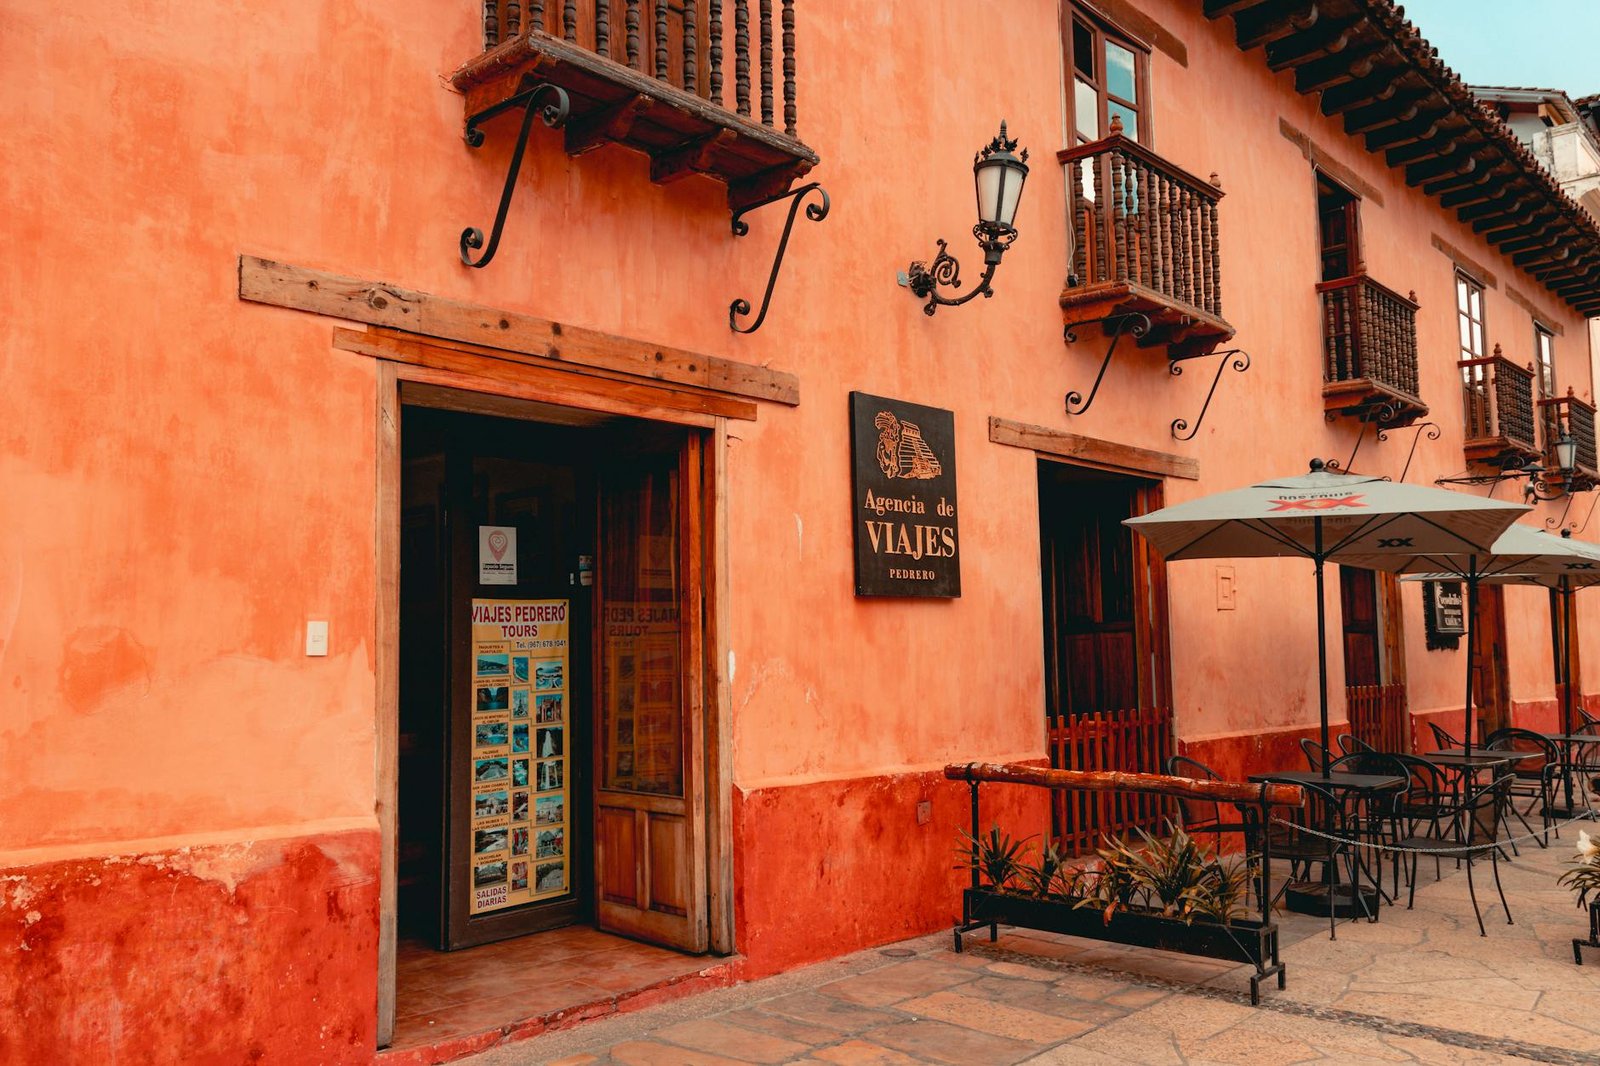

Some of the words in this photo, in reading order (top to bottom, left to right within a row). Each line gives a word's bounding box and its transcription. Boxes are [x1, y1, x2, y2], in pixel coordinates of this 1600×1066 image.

[864, 488, 925, 516] Agencia
[937, 496, 955, 517] de
[865, 520, 956, 560] VIAJES
[1376, 537, 1415, 548] XX
[889, 568, 935, 580] PEDRERO
[472, 605, 511, 623] VIAJES
[515, 604, 566, 622] PEDRERO
[501, 625, 538, 637] TOURS
[476, 885, 507, 900] SALIDAS
[477, 895, 507, 908] DIARIAS
